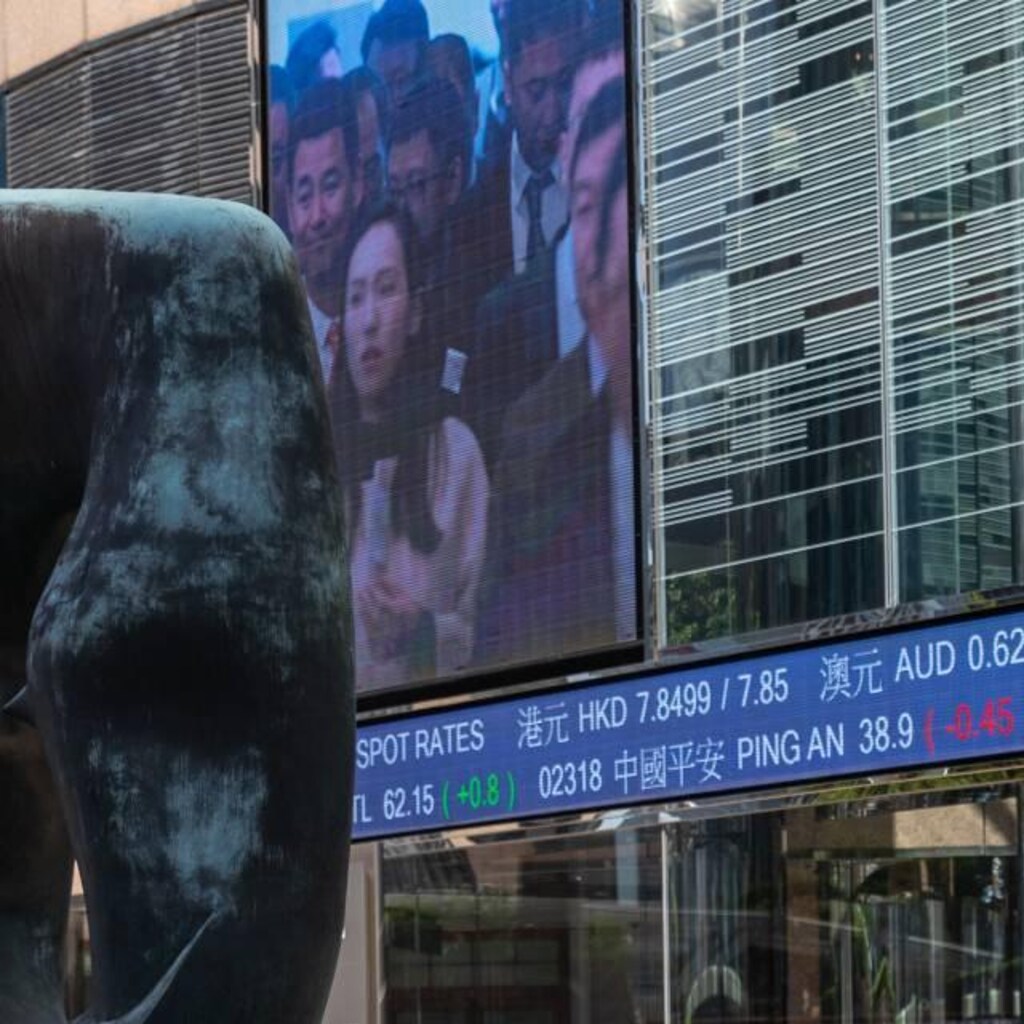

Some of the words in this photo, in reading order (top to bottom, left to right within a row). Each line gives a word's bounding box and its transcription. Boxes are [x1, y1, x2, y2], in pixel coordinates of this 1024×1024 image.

[352, 794, 372, 825] TL
[384, 784, 434, 819] 62.15
[539, 759, 602, 798] 02318
[615, 738, 724, 793] 中國平安
[738, 730, 800, 769] PING
[807, 723, 844, 760] AN
[923, 705, 936, 756] 38.9
[356, 731, 410, 769] SPOT
[416, 719, 484, 758] RATES
[518, 702, 569, 748] 港元
[579, 696, 627, 732] HKD
[636, 681, 711, 723] 7.8499
[738, 668, 788, 707] 7.85
[820, 648, 883, 701] 澳元
[895, 641, 955, 682] AUD
